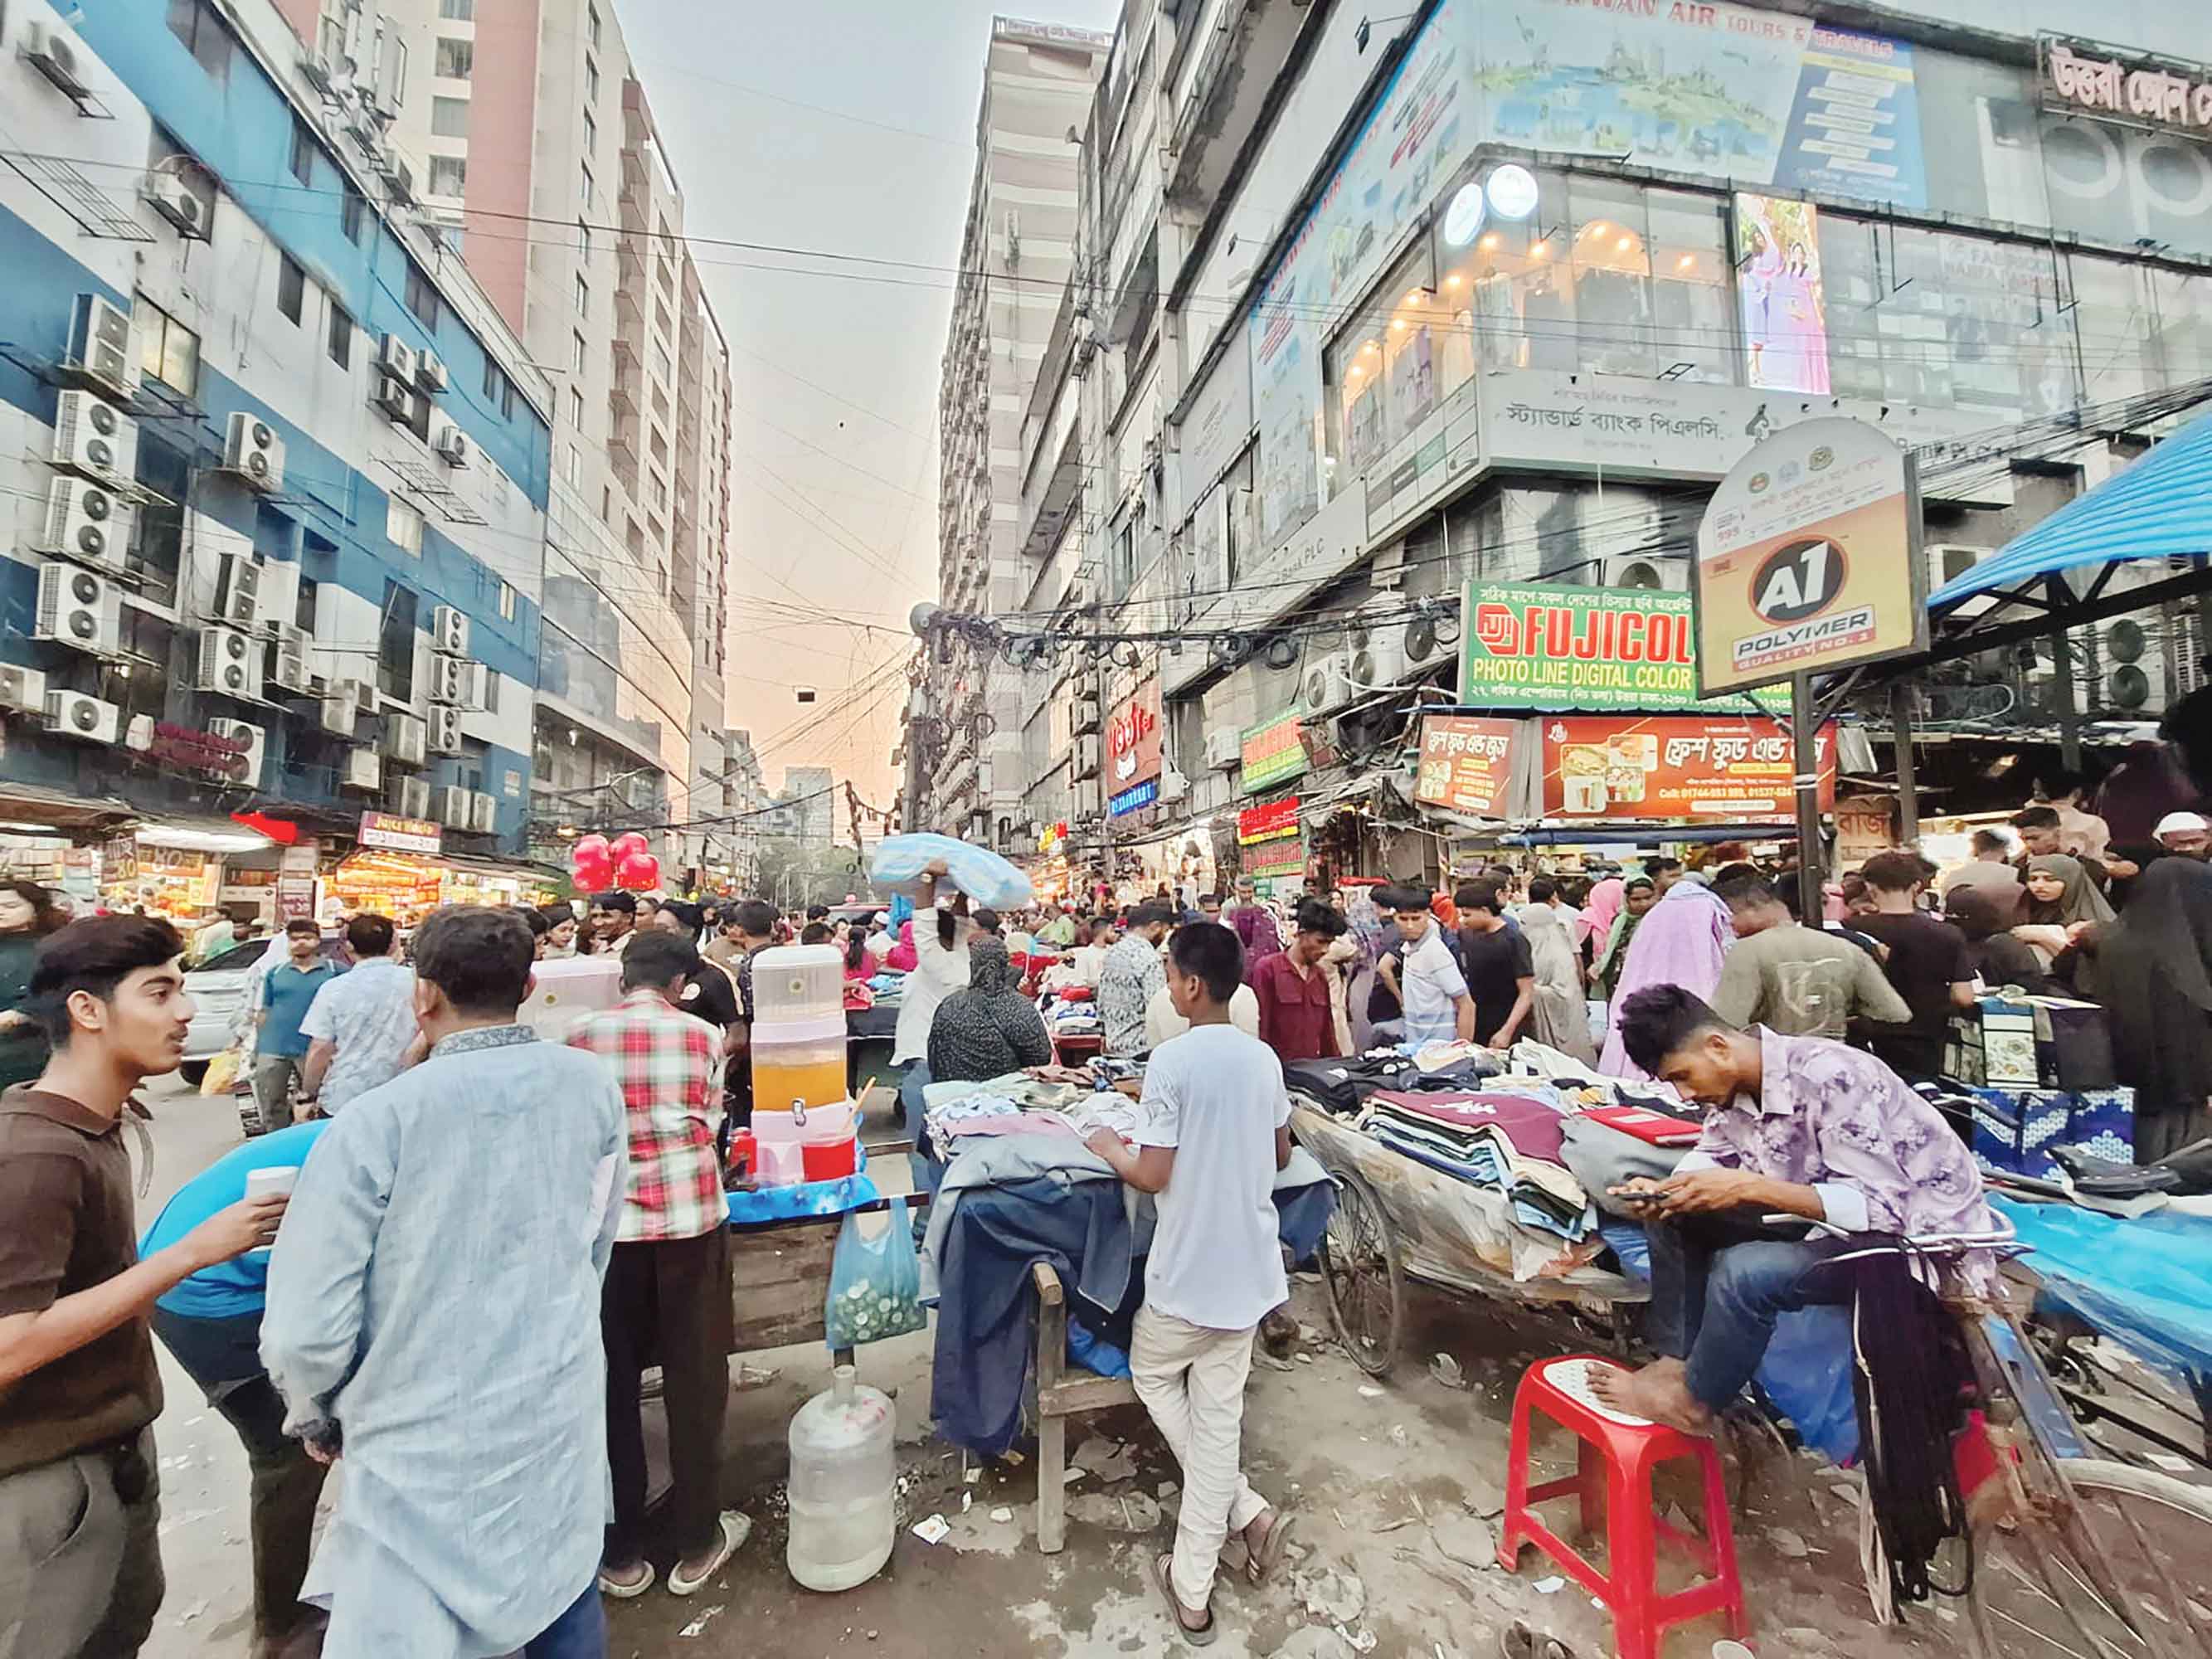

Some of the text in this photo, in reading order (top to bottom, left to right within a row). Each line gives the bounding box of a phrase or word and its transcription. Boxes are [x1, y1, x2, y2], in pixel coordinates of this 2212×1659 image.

[1668, 1, 1716, 27] AIR
[1725, 16, 1786, 39] TOURS
[2048, 36, 2125, 110] উত্তরা
[1590, 412, 1642, 433] ব্যাংক
[1756, 541, 1829, 617] A1
[1524, 606, 1695, 664] FUJICOL
[1738, 611, 1868, 656] POLYMER
[1738, 631, 1869, 669] QUALITY NO. 1
[1473, 659, 1693, 691] PHOTO LINE DIGITAL COLOR
[1665, 735, 1711, 767] ফ্রেশ
[1712, 737, 1751, 771] ফুড
